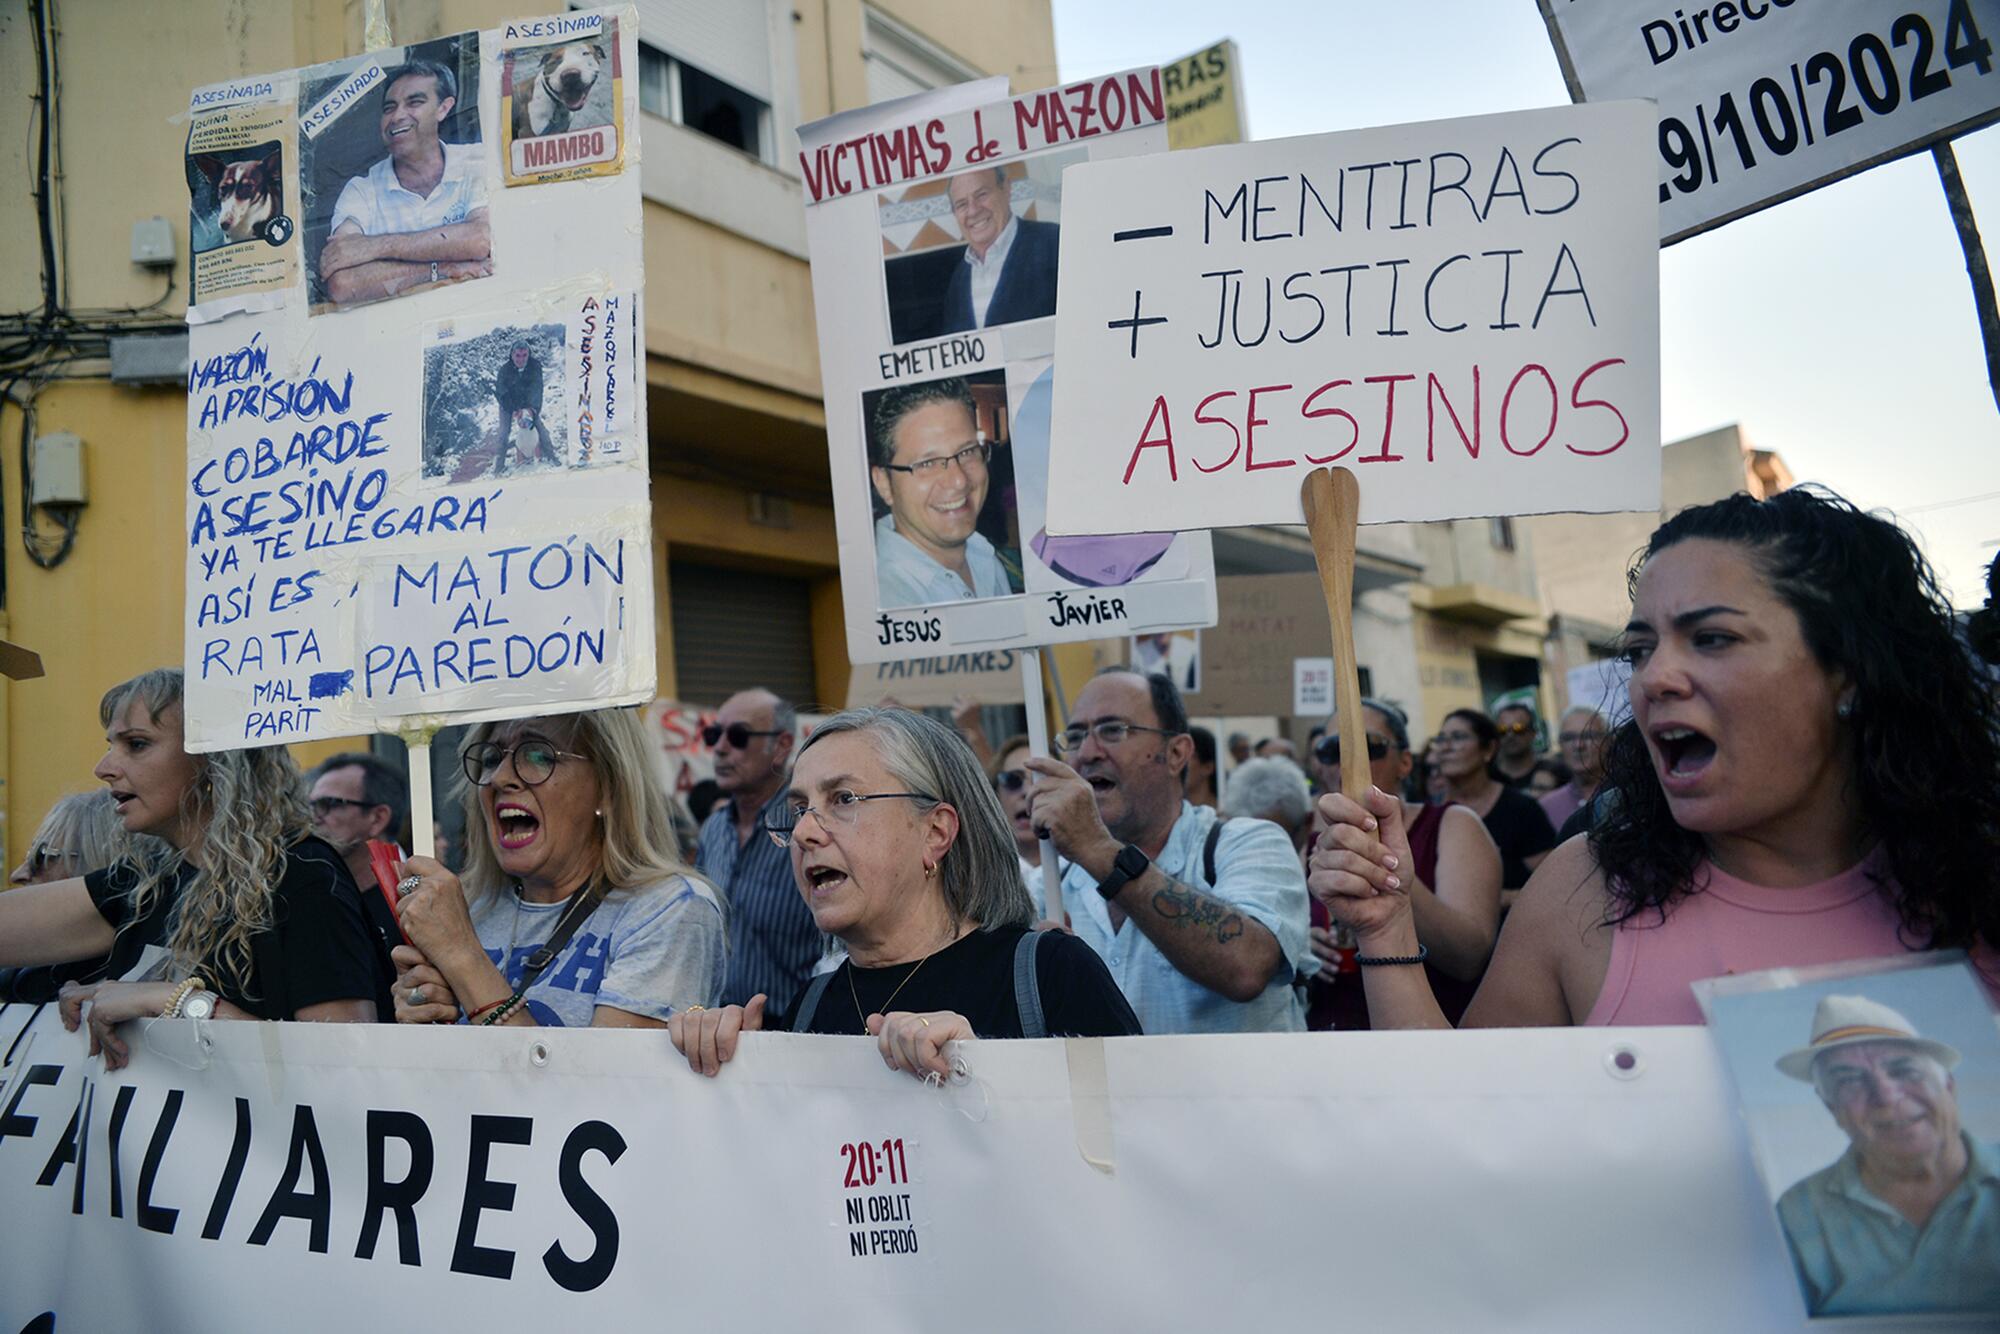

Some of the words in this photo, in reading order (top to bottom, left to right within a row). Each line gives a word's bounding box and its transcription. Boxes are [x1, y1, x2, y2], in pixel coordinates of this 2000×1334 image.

[505, 15, 602, 39] ASESINADO
[1641, 0, 1796, 66] Direc
[191, 82, 273, 106] ASESINADA
[302, 64, 381, 133] ASESINADO
[966, 109, 1009, 163] de
[1013, 68, 1166, 150] MAZON
[1658, 0, 1993, 203] 9/10/2024
[193, 127, 230, 139] PERDIDA
[523, 132, 604, 168] MAMBO
[1204, 138, 1582, 244] MENTIRAS
[1198, 243, 1597, 348] JUSTICIA
[879, 335, 985, 380] EMETERIO
[1123, 358, 1630, 485] ASESINOS
[192, 412, 392, 498] COBARDE
[191, 467, 389, 547] ASESINO
[200, 544, 239, 581] YA
[253, 530, 296, 563] TE
[304, 489, 503, 551] LLEGARÁ
[393, 534, 623, 608] MATÓN
[198, 572, 256, 628] ASÍ
[453, 599, 509, 634] AL
[876, 609, 941, 645] JESÚS
[1047, 591, 1128, 627] JAVIER
[202, 628, 321, 680] RATA
[365, 616, 604, 698] PAREDÓN
[253, 679, 302, 706] MAL
[245, 704, 322, 739] PARIT
[840, 1138, 908, 1188] 20:11
[846, 1197, 865, 1224] NI
[868, 1194, 911, 1222] OBLIT
[850, 1231, 867, 1257] NI
[870, 1224, 918, 1255] PERDÓ
